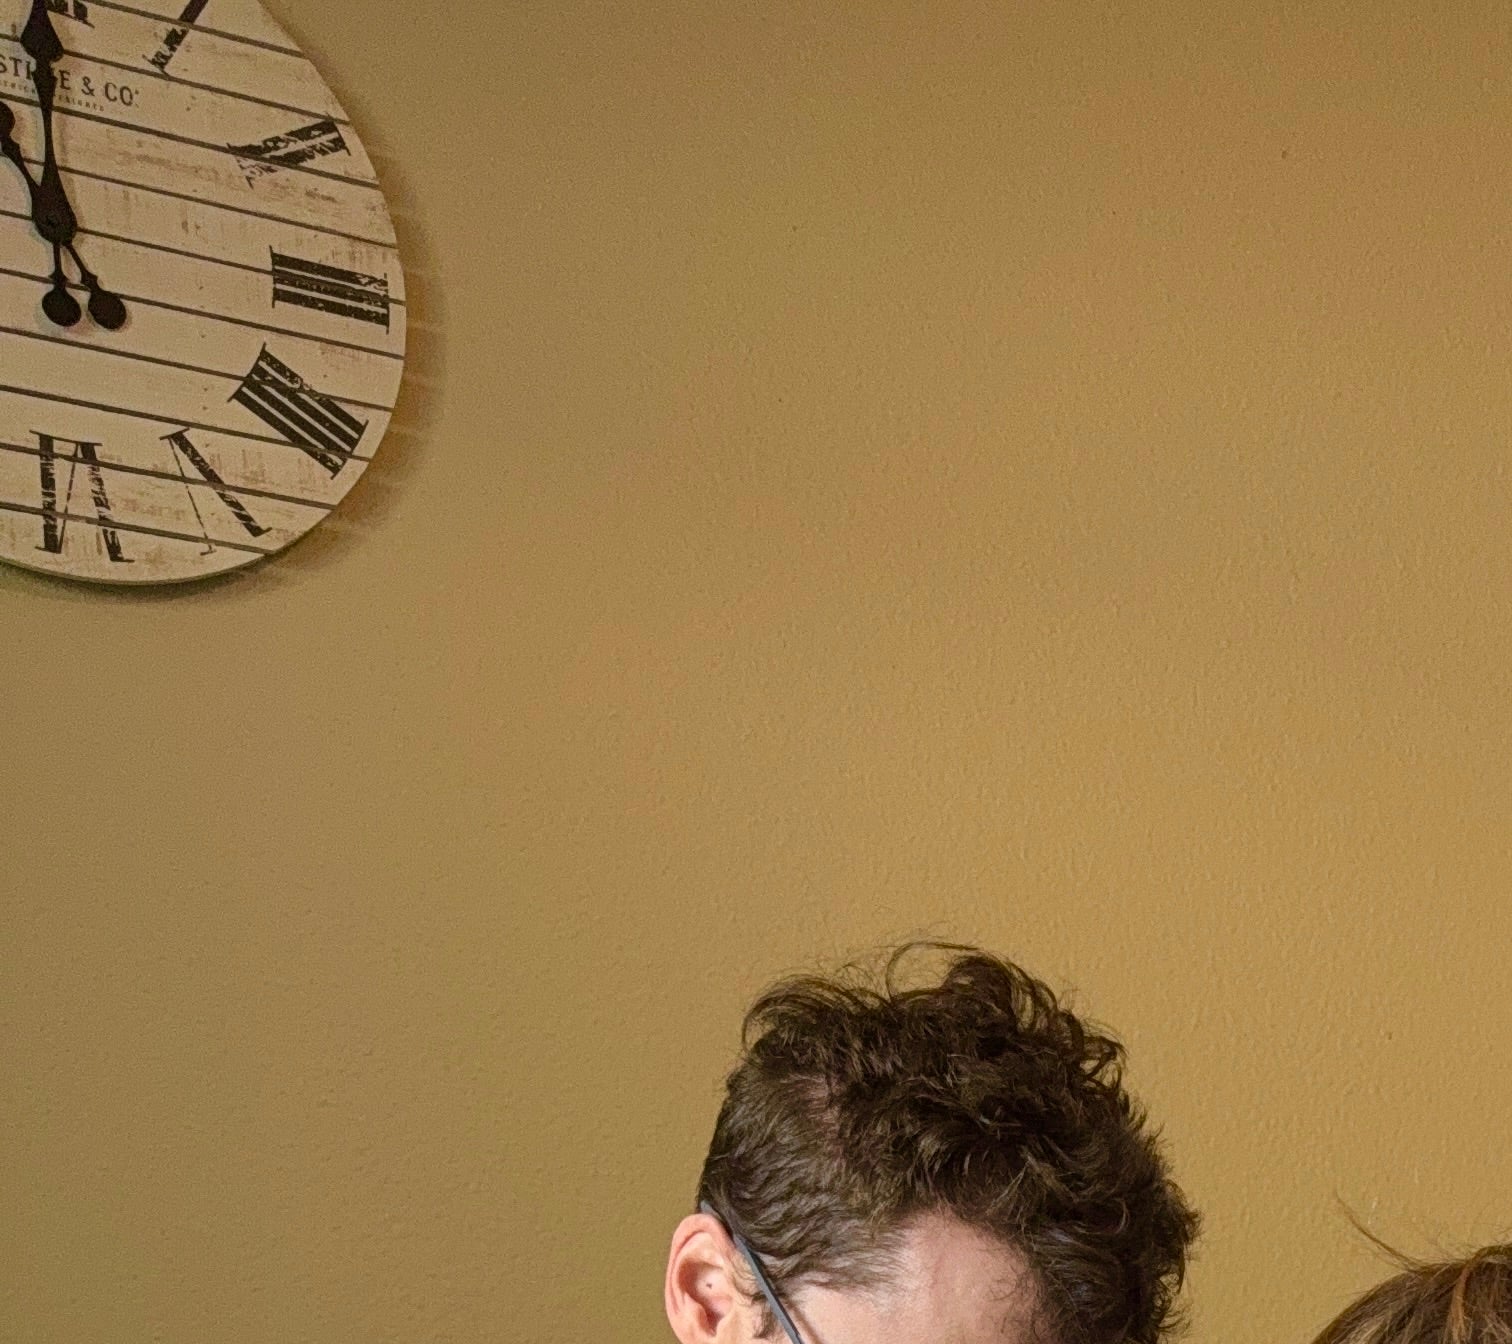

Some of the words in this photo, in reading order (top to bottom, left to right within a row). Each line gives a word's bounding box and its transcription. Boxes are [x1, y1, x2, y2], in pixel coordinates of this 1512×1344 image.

[0, 53, 71, 91] STIE
[81, 75, 96, 97] &
[268, 245, 390, 335] III
[227, 342, 369, 480] IIII
